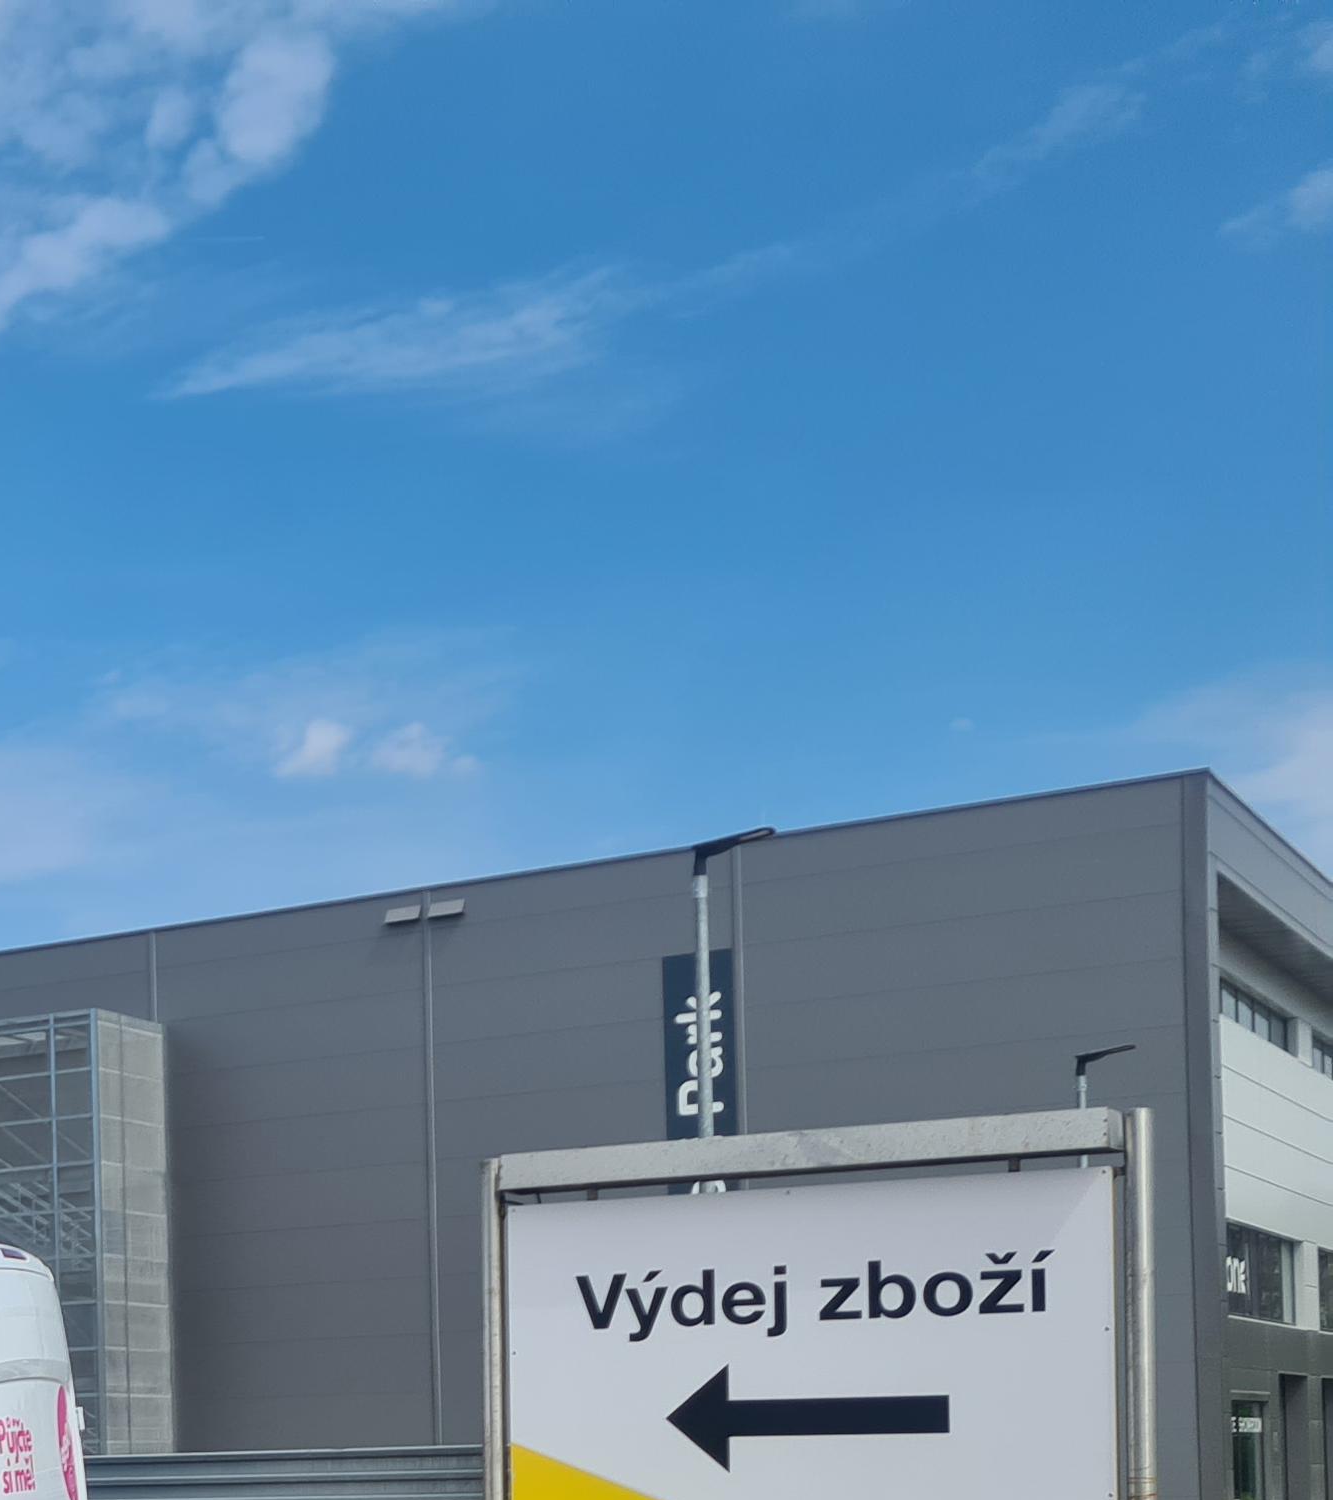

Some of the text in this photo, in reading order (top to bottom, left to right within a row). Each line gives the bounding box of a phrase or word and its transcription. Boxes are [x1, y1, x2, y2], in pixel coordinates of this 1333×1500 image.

[674, 991, 725, 1116] Park
[575, 1249, 1056, 1342] Výdej zboží
